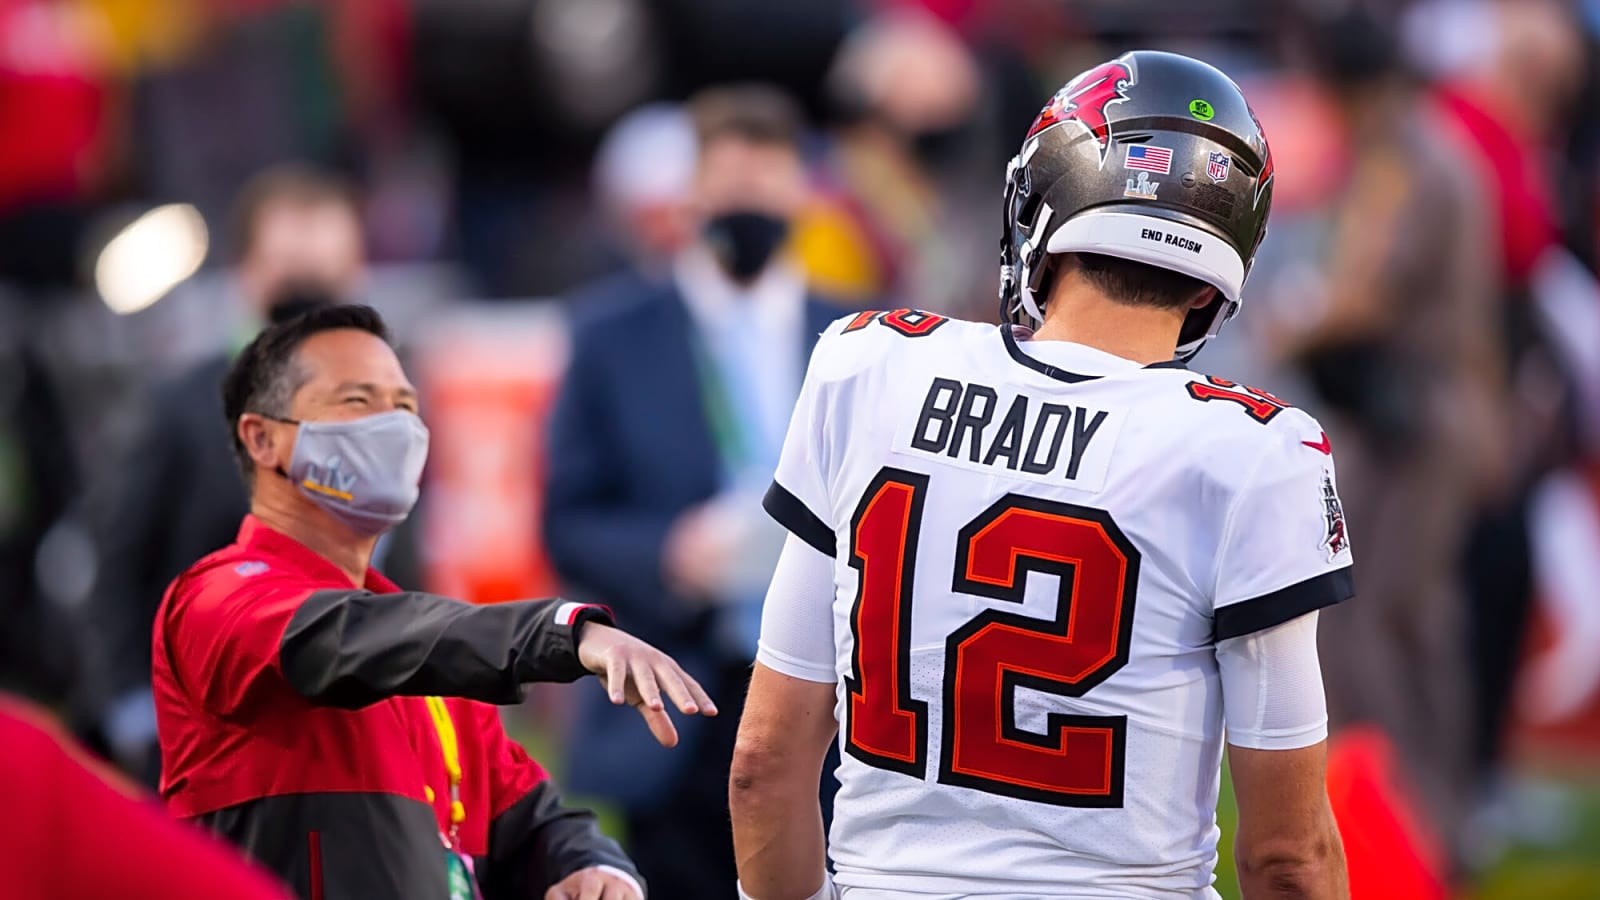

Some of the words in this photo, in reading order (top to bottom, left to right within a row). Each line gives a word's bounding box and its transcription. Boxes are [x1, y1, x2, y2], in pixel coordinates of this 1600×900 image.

[1209, 162, 1226, 179] NFL
[1141, 228, 1163, 242] END
[1165, 234, 1203, 254] RACISM
[1185, 375, 1293, 425] 1
[911, 377, 1109, 480] BRADY
[844, 466, 1141, 808] 12
